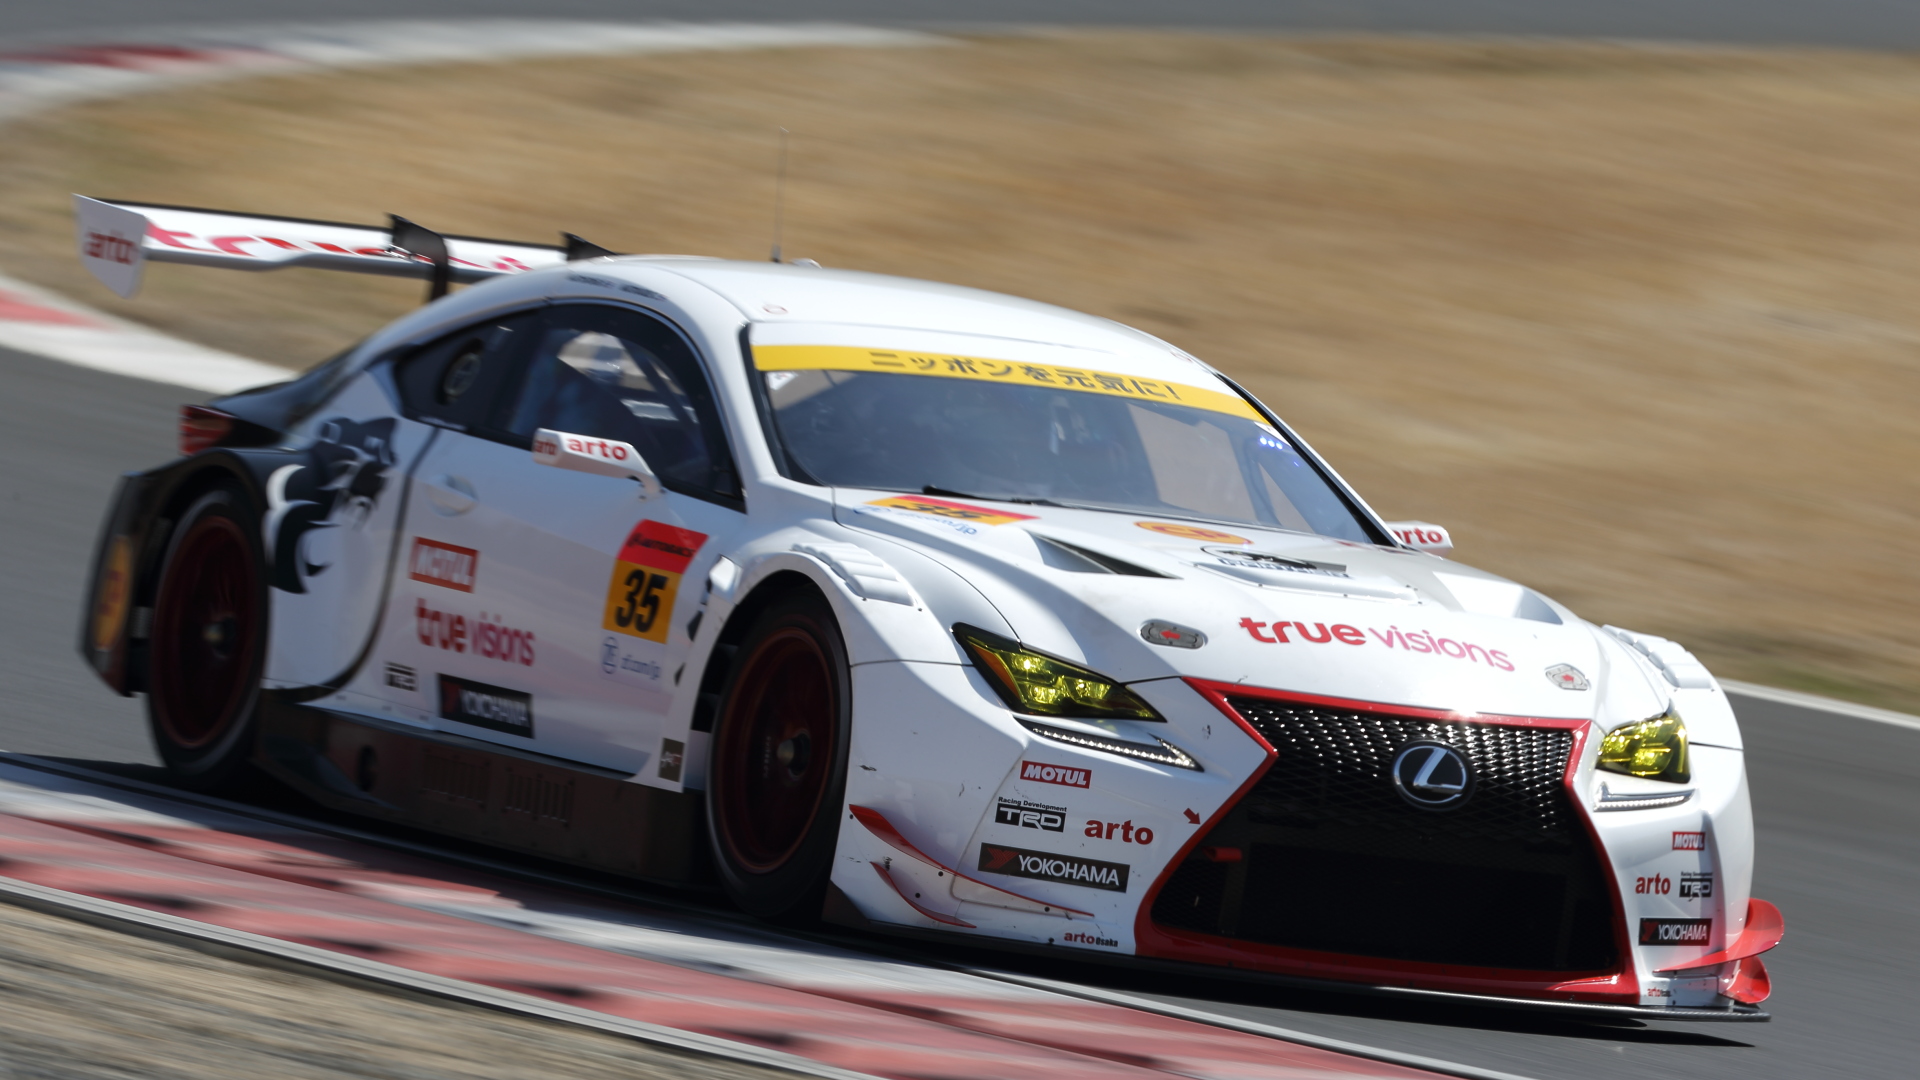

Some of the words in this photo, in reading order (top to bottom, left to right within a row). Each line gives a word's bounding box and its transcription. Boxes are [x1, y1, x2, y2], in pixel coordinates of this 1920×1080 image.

[567, 439, 628, 461] arto
[615, 568, 669, 633] 35
[415, 598, 467, 653] true
[469, 611, 535, 667] visions
[1239, 617, 1367, 646] true
[1369, 625, 1515, 672] visions
[1023, 764, 1087, 786] MOTUL
[998, 796, 1021, 806] Racing
[1023, 800, 1067, 812] Development
[1000, 806, 1062, 830] TRD
[1084, 819, 1154, 845] arto
[1674, 834, 1703, 848] MOTUL
[1018, 855, 1120, 886] YOKOHAMA
[1635, 873, 1671, 894] arto
[1064, 932, 1095, 945] arto
[1658, 924, 1707, 940] YOKOHAMA
